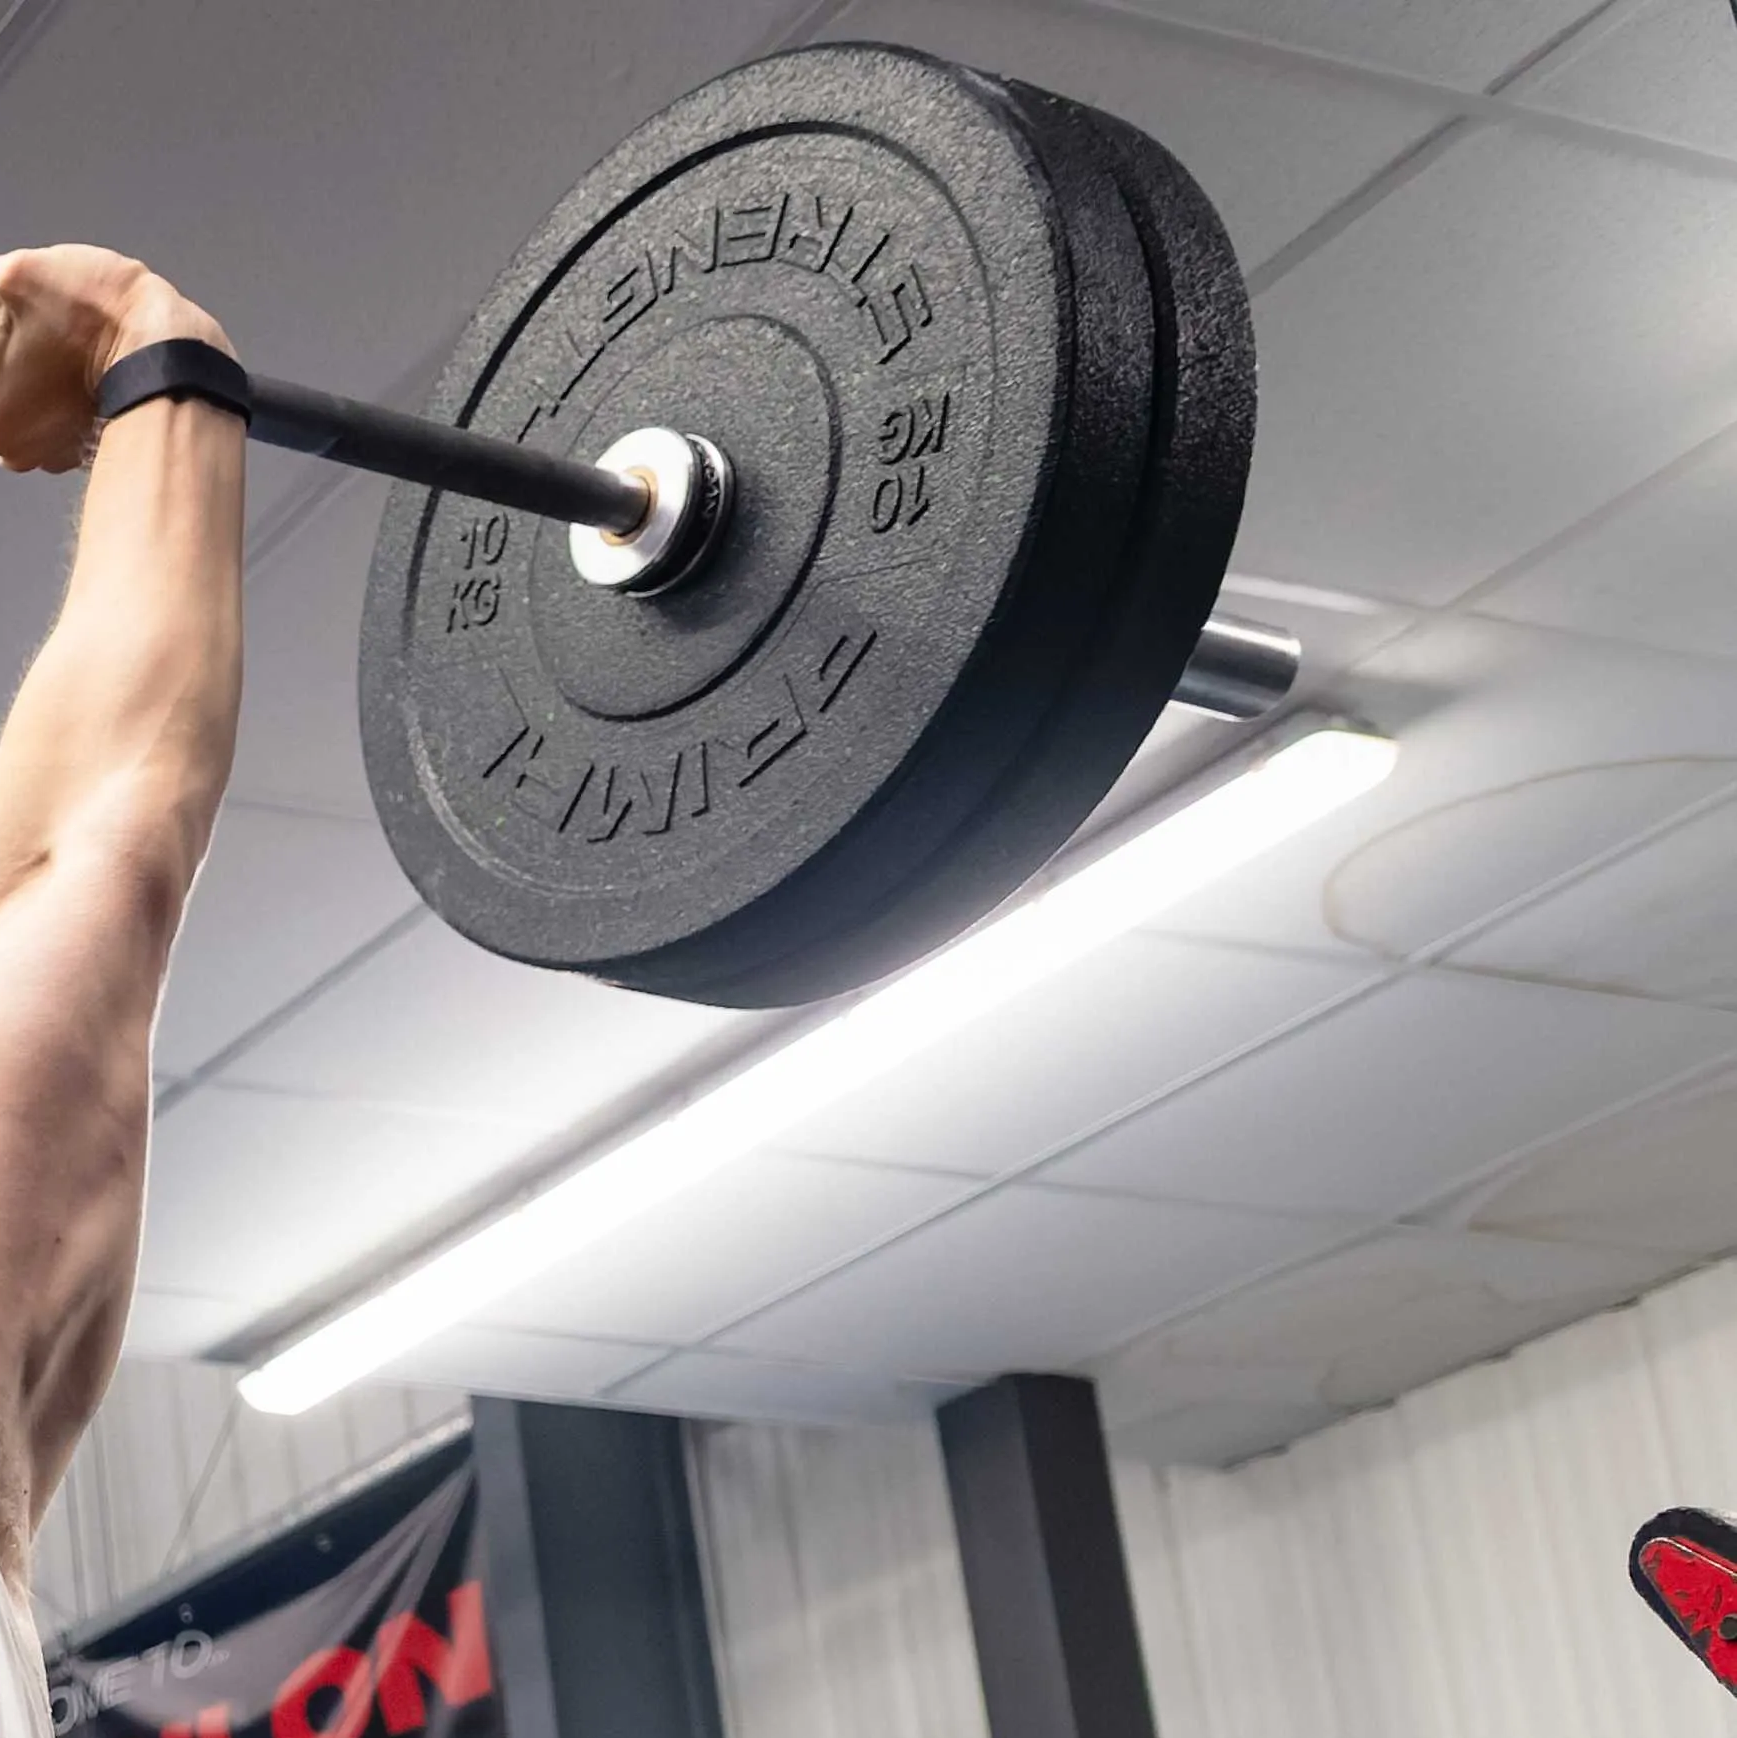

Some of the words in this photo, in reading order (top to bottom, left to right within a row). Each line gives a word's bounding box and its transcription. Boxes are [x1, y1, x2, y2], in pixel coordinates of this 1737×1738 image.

[880, 392, 951, 467] KG
[872, 466, 930, 534] 10
[459, 512, 509, 571] 10
[445, 577, 502, 634] KG
